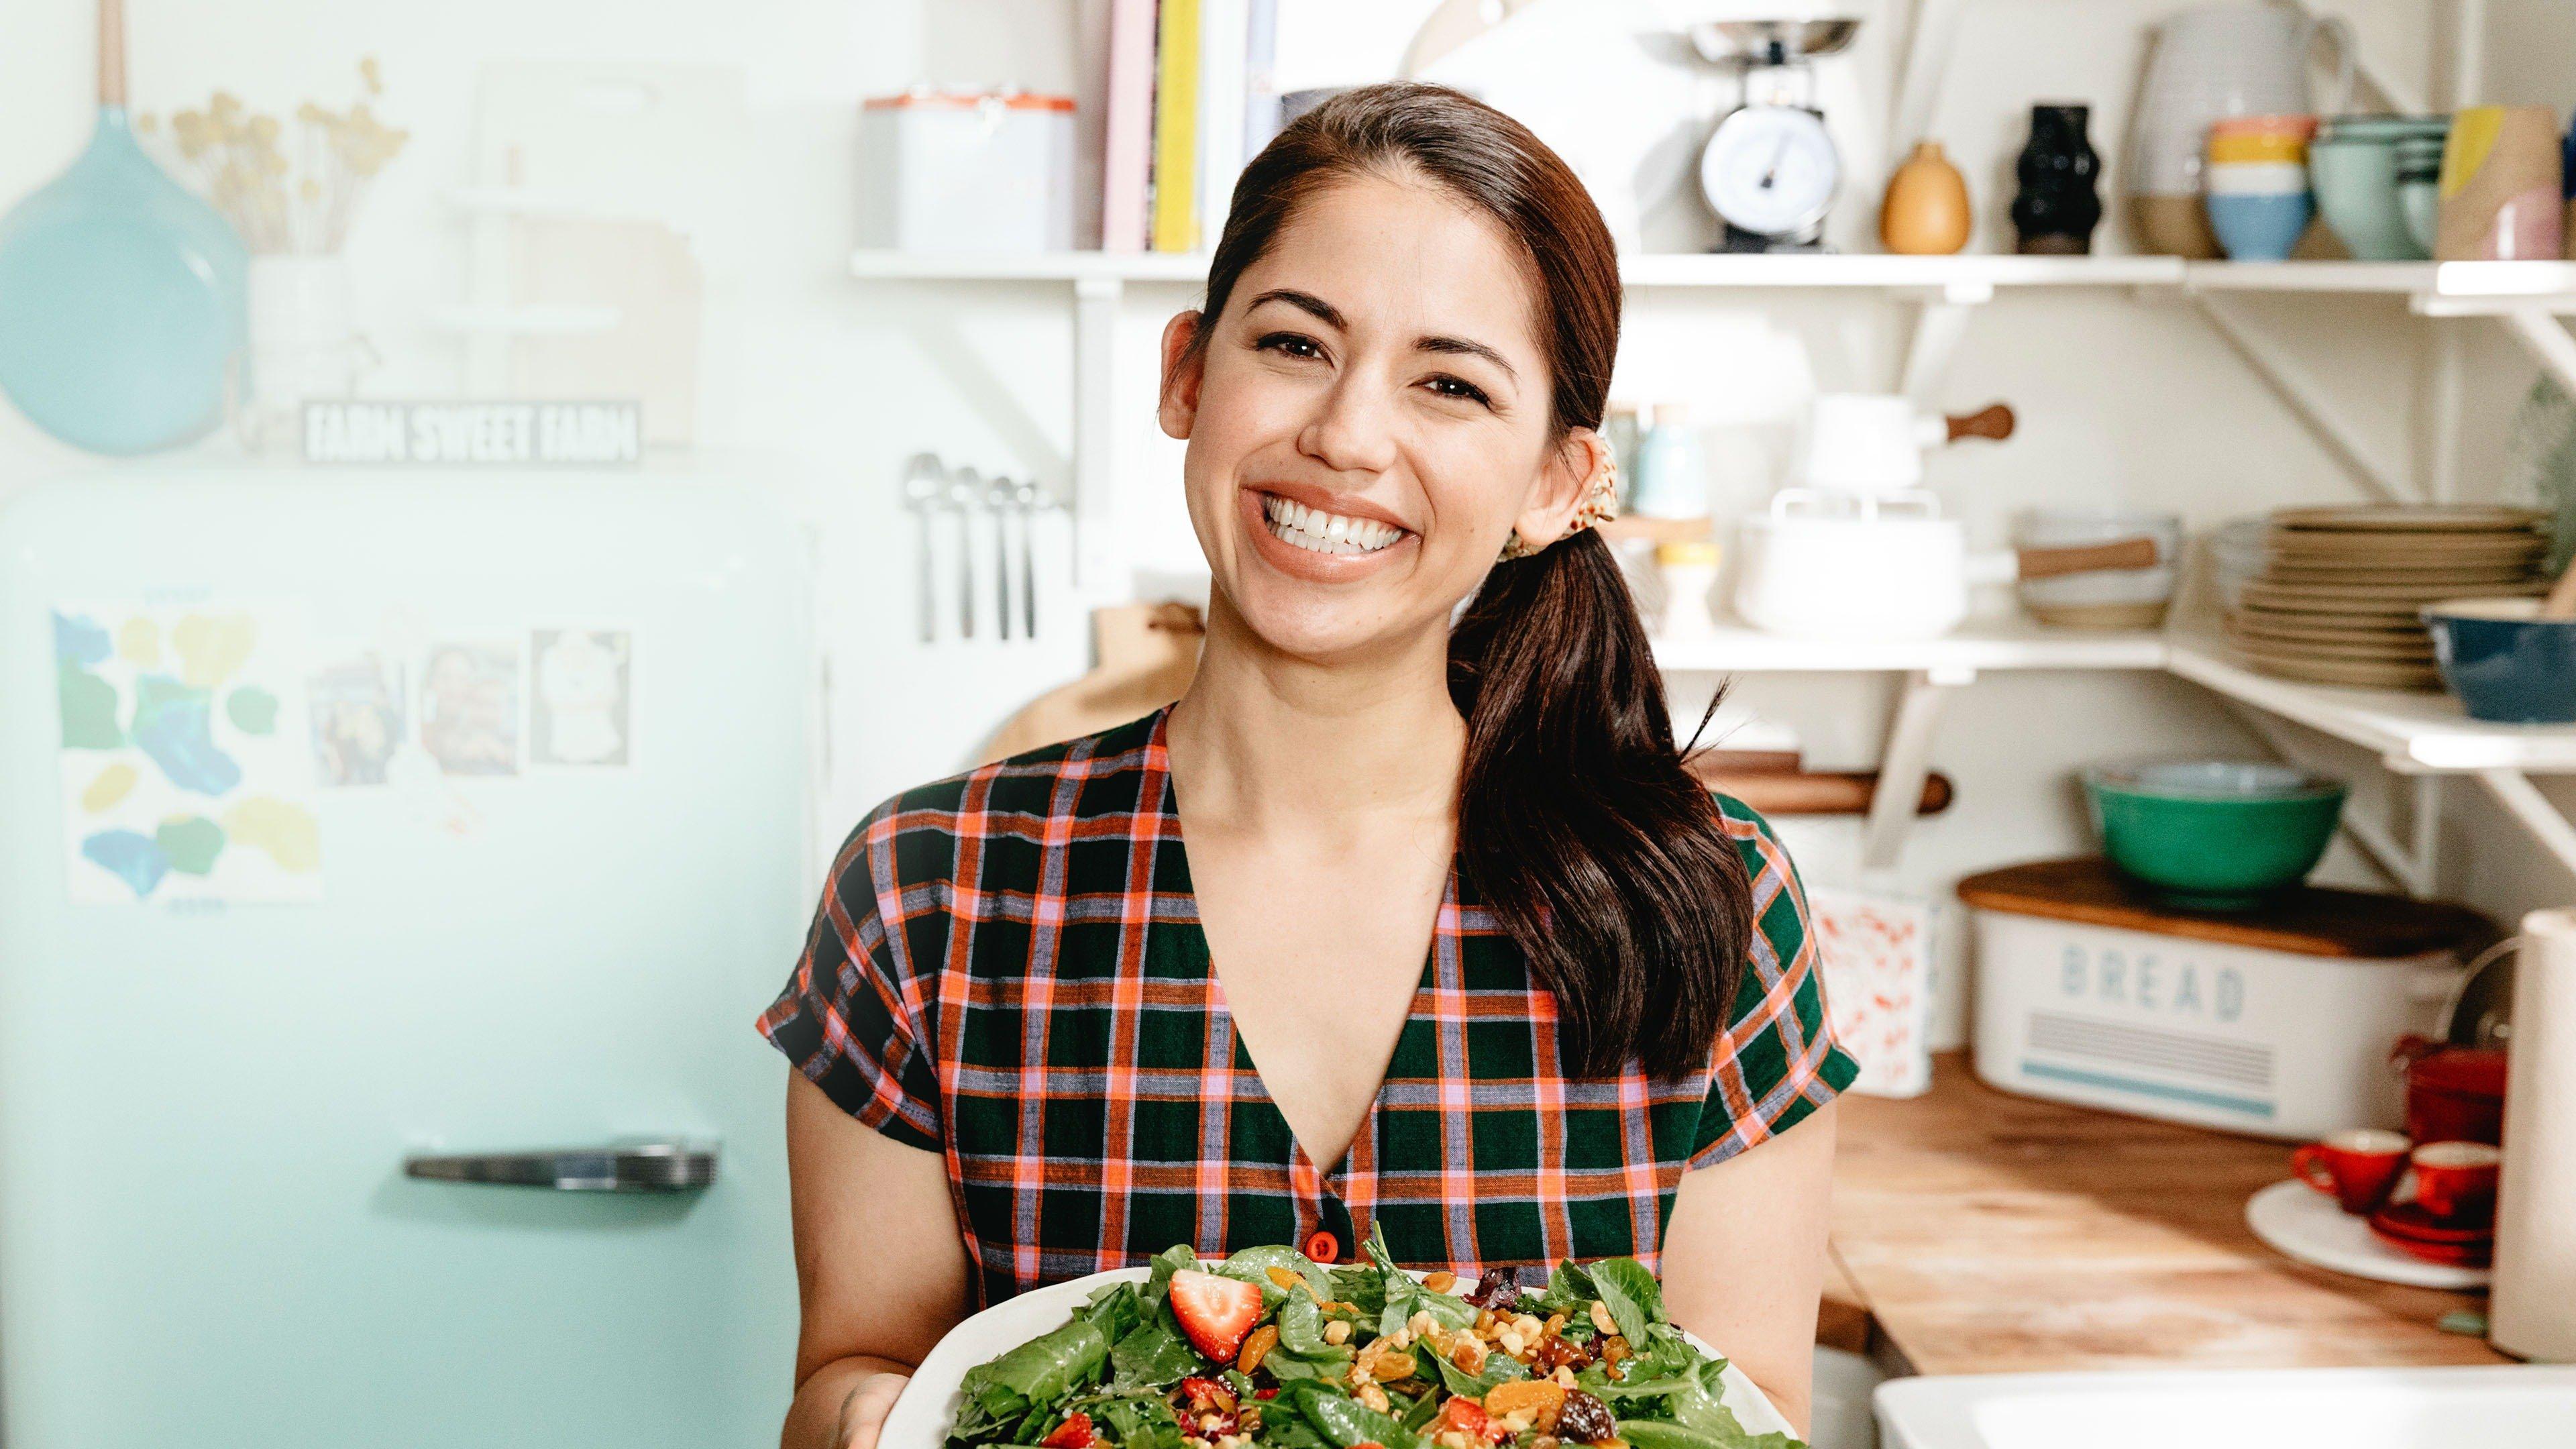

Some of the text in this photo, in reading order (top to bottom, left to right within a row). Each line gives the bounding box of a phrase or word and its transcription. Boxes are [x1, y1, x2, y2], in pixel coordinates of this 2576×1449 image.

[307, 405, 638, 462] FARM SWEET FARM
[2061, 945, 2244, 1023] BREAD
